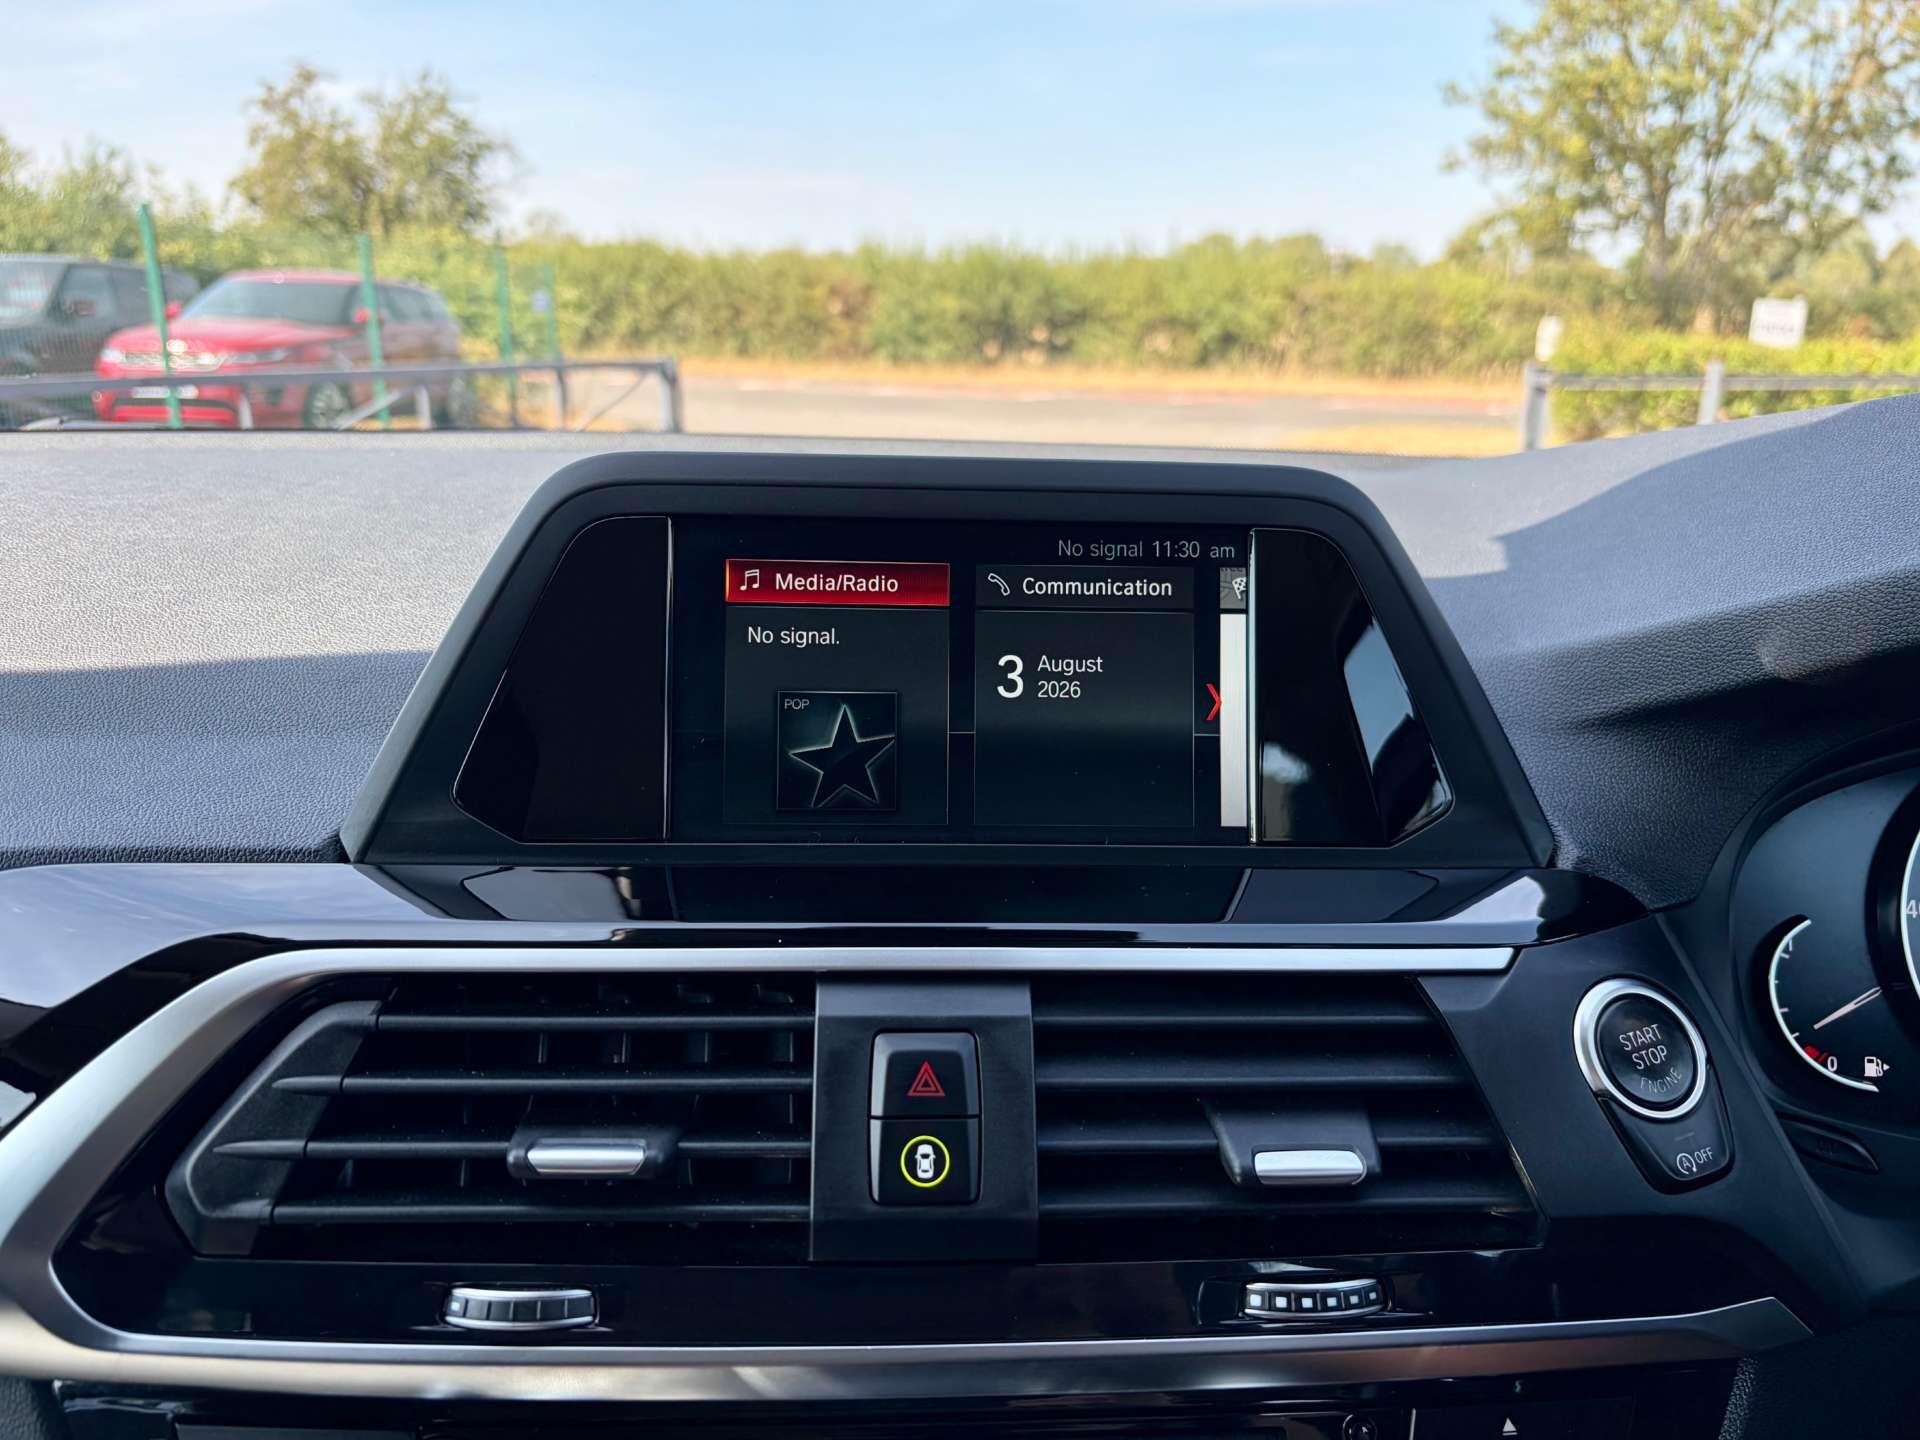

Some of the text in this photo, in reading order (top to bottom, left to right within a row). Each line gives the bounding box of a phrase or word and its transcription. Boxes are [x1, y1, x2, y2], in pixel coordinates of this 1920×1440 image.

[1058, 539, 1235, 561] No signal 11:30 am
[775, 572, 899, 593] Media/Radio
[1022, 577, 1173, 596] Communication
[747, 626, 840, 648] No signal.
[1037, 654, 1103, 676] August
[997, 654, 1024, 699] 3
[1037, 680, 1081, 699] 2026
[784, 698, 810, 710] POP
[1619, 1023, 1661, 1051] START
[1632, 1045, 1667, 1070] STOP
[1827, 1055, 1838, 1072] 0
[1640, 1066, 1682, 1095] ENGINE
[1694, 1146, 1713, 1164] OFF
